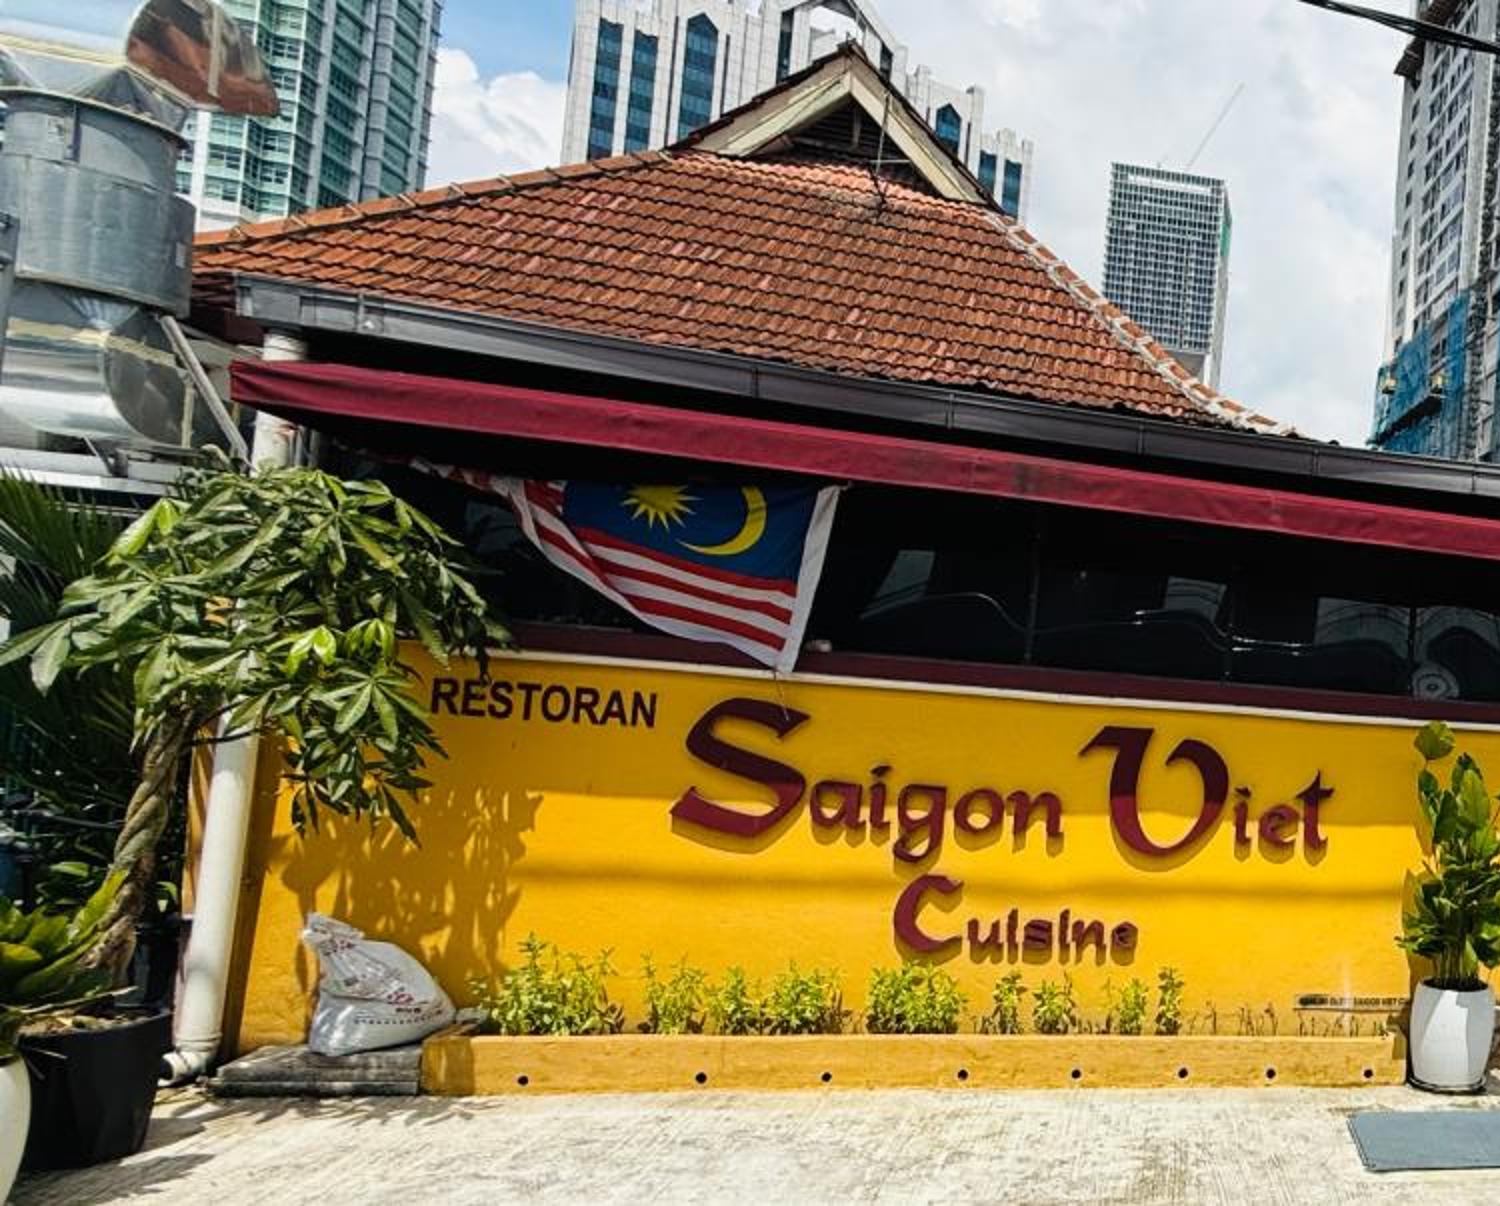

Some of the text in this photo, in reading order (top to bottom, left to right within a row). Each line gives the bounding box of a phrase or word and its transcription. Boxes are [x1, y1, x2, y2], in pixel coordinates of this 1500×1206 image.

[431, 677, 657, 728] RESTORAN
[669, 697, 1335, 863] Saigon Viet
[893, 874, 1138, 953] Cuisine
